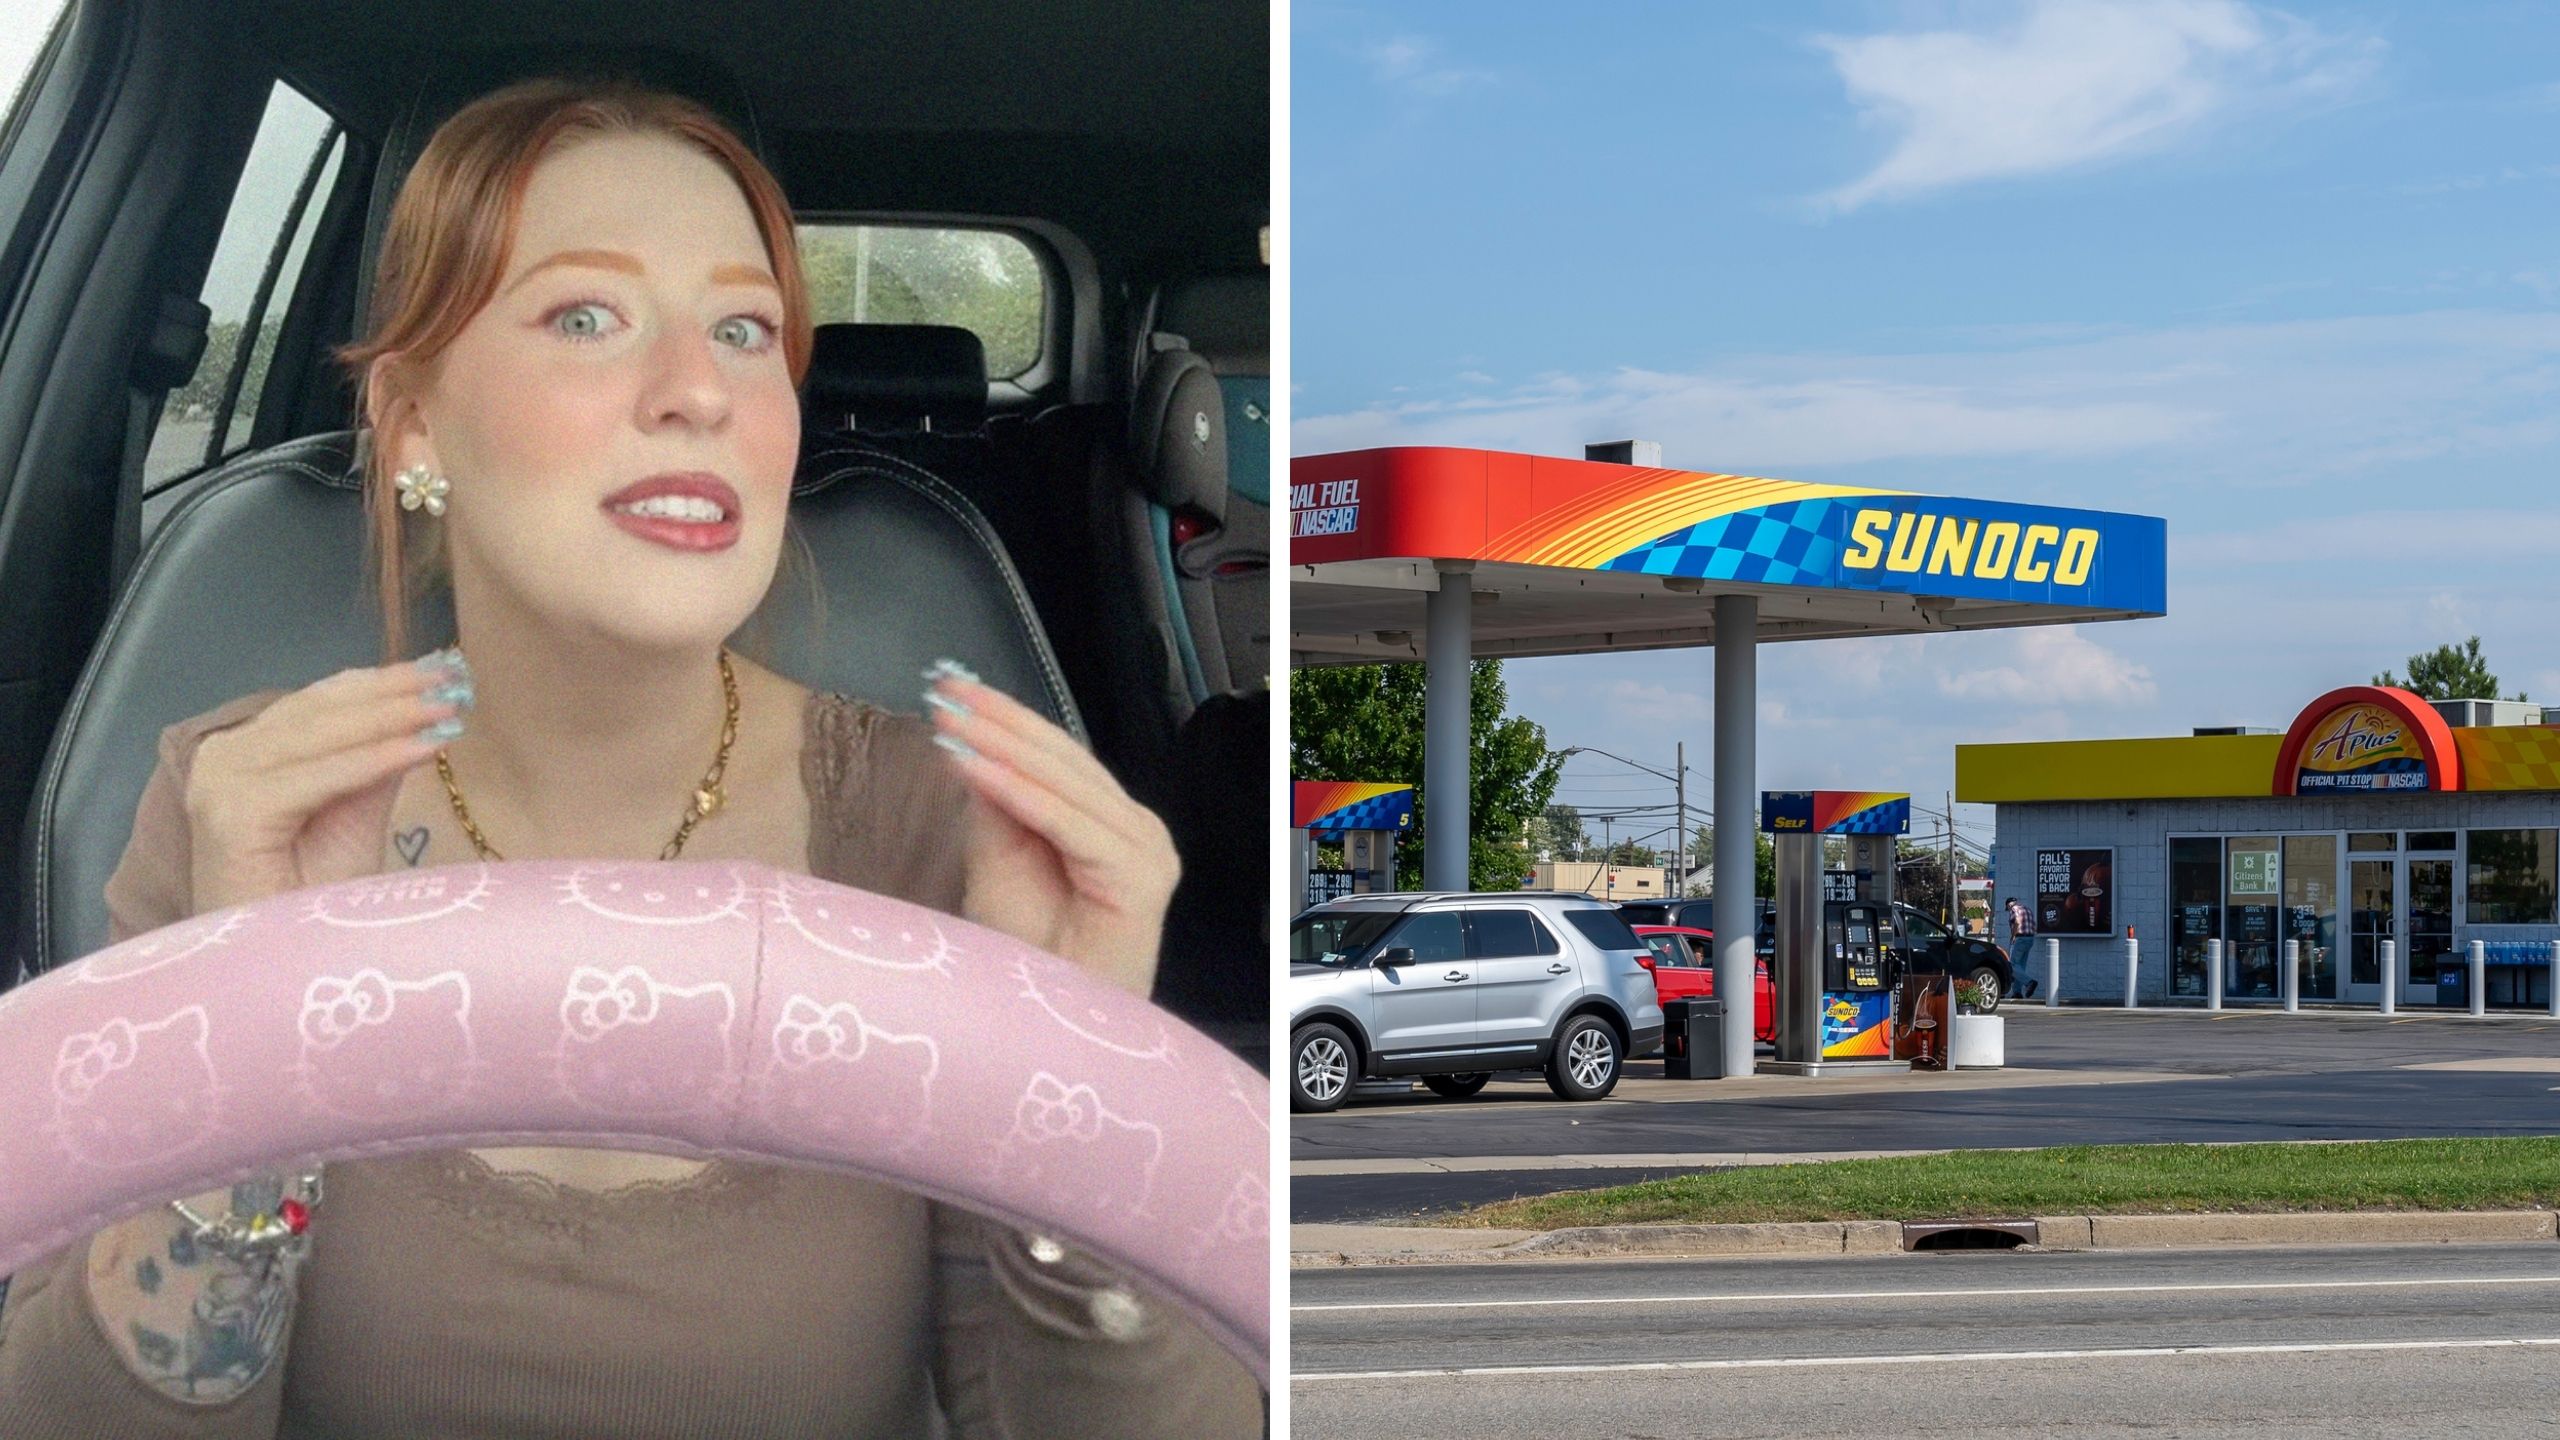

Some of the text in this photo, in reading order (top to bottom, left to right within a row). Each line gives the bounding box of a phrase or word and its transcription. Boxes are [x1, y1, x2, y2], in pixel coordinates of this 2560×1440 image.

[1319, 479, 1360, 506] FUEL
[1299, 507, 1355, 536] NASCAR
[1842, 509, 2099, 586] SUNOCO
[2300, 772, 2426, 788] OFFICIAL PIT STOP NASCAR
[1399, 813, 1409, 827] 5
[1774, 816, 1807, 828] SELF
[1901, 819, 1907, 831] 1
[2039, 851, 2071, 865] FALL'S
[2039, 865, 2071, 873] FAVORITE
[2268, 854, 2276, 892] ATM
[2039, 873, 2071, 883] FLAVOR
[2234, 871, 2264, 881] Citizens
[2039, 883, 2070, 893] IS BACK
[2239, 881, 2258, 890] Bank
[1827, 1007, 1859, 1017] SUNOCO
